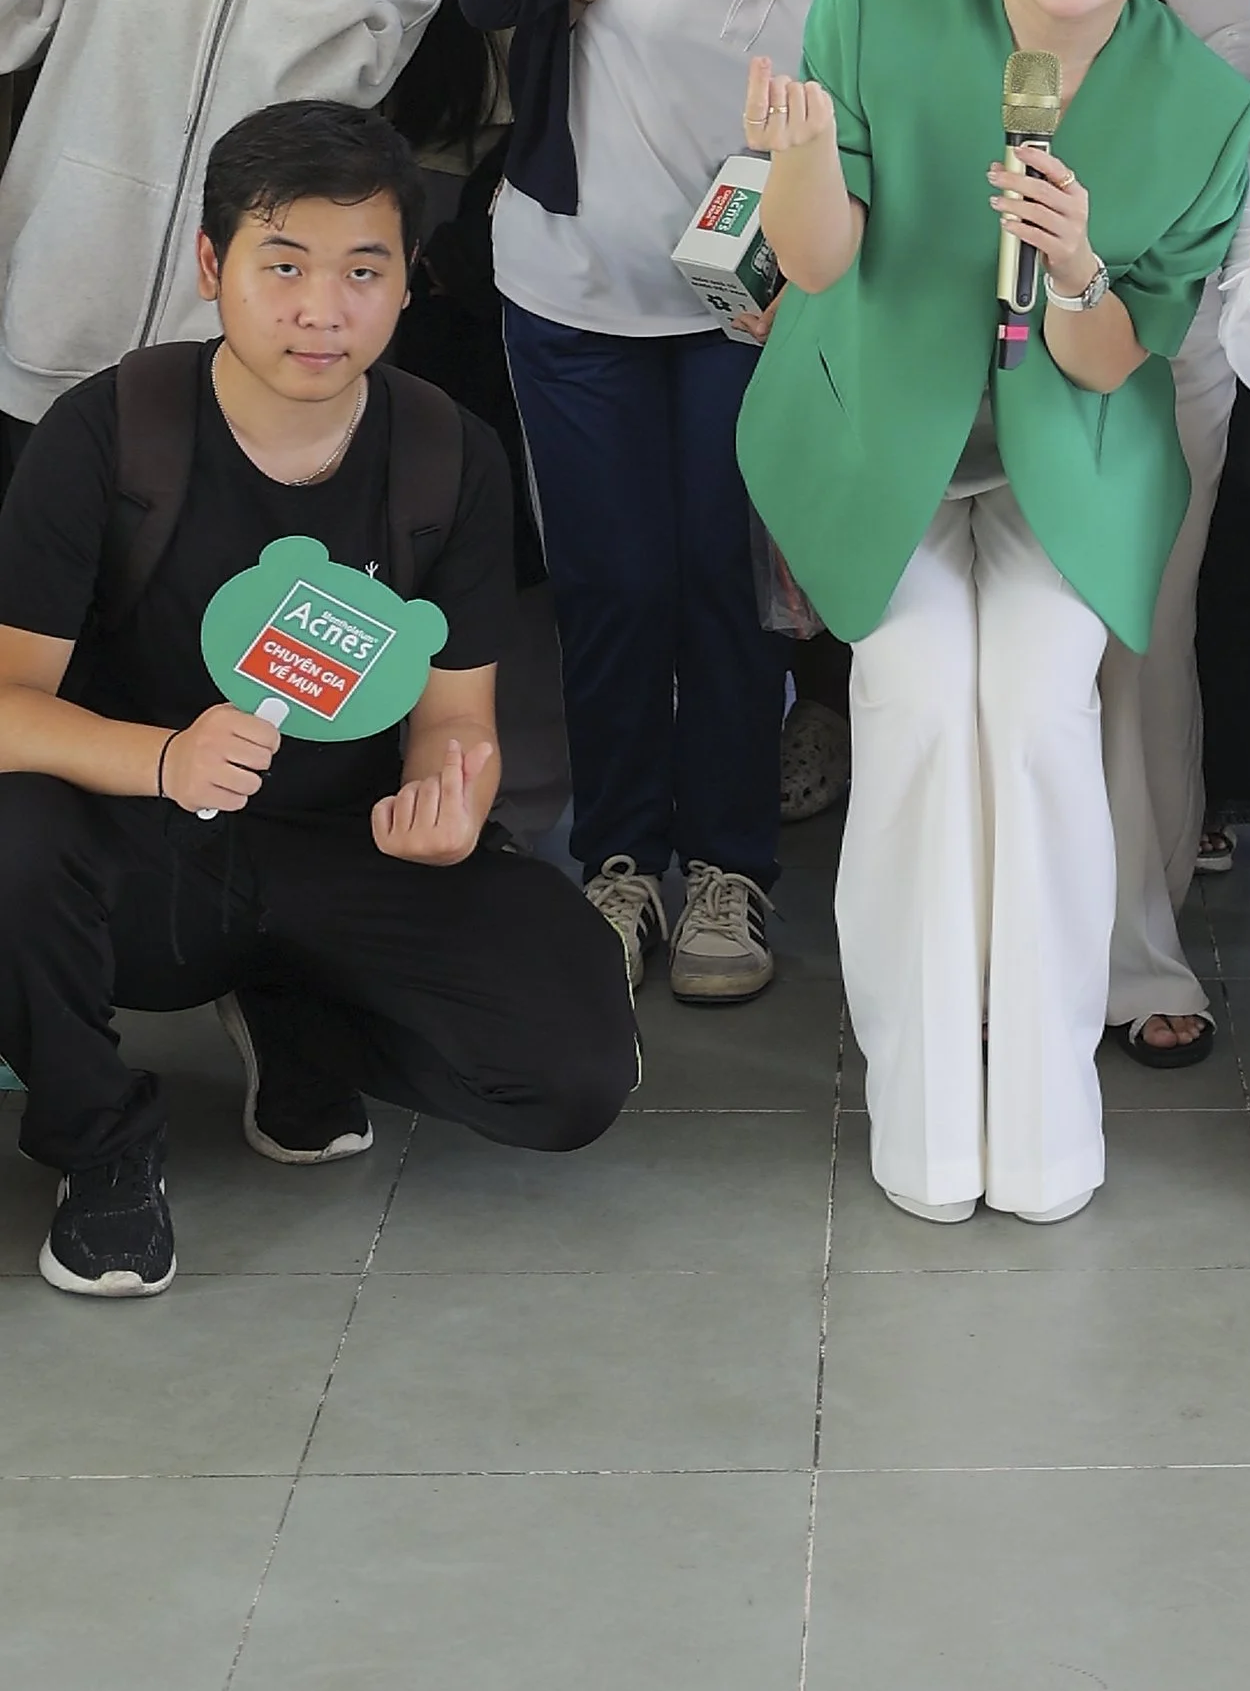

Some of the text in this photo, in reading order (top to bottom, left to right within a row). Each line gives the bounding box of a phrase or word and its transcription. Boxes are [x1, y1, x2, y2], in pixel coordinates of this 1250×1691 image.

[284, 602, 373, 660] Acnes
[263, 641, 346, 691] CHUYÊN GIA
[287, 673, 323, 698] MỤN
